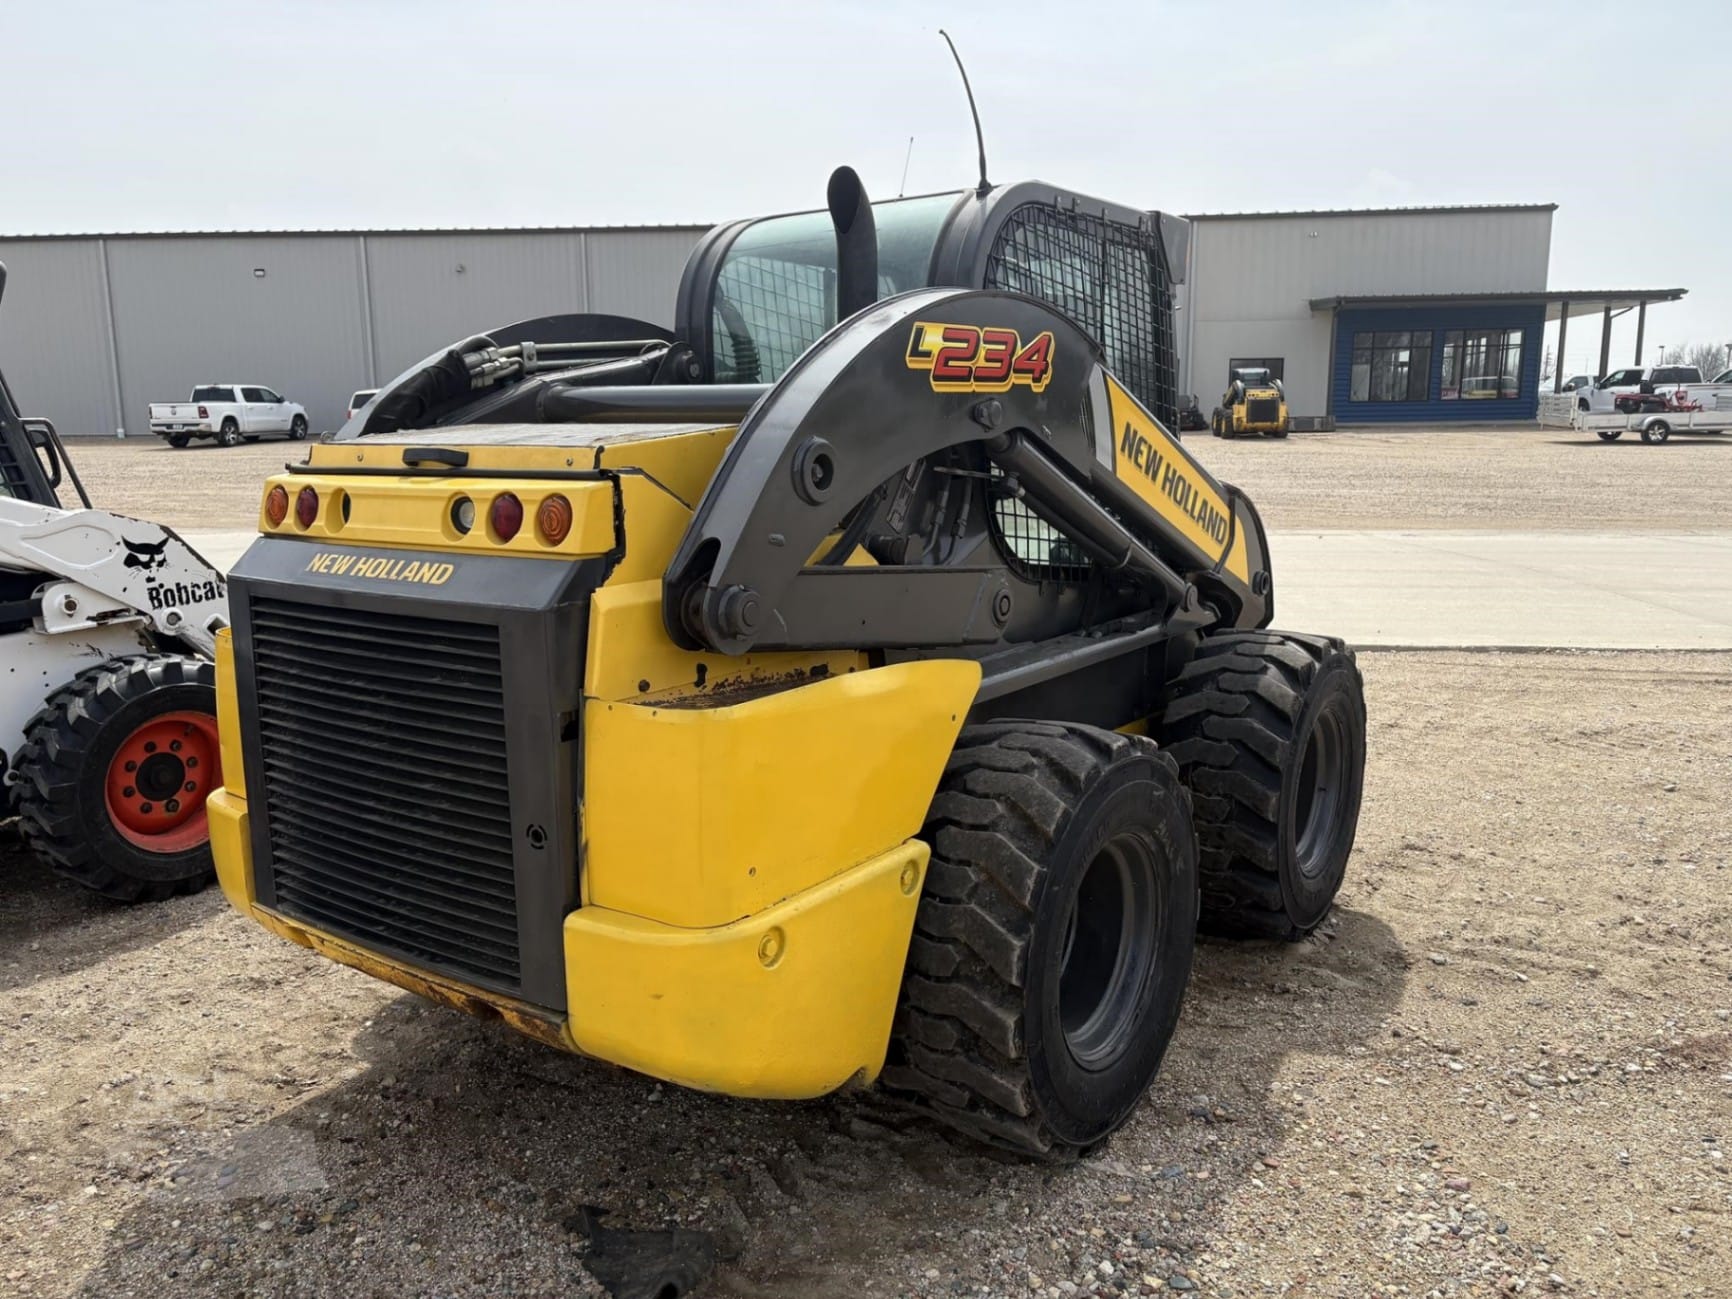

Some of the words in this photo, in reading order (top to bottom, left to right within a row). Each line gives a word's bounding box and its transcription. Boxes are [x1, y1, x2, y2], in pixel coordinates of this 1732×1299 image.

[907, 323, 1054, 391] L234
[1120, 421, 1164, 482] NEW
[1161, 462, 1228, 545] HOLLAND
[304, 553, 356, 575] NEW
[350, 556, 455, 585] HOLLAND
